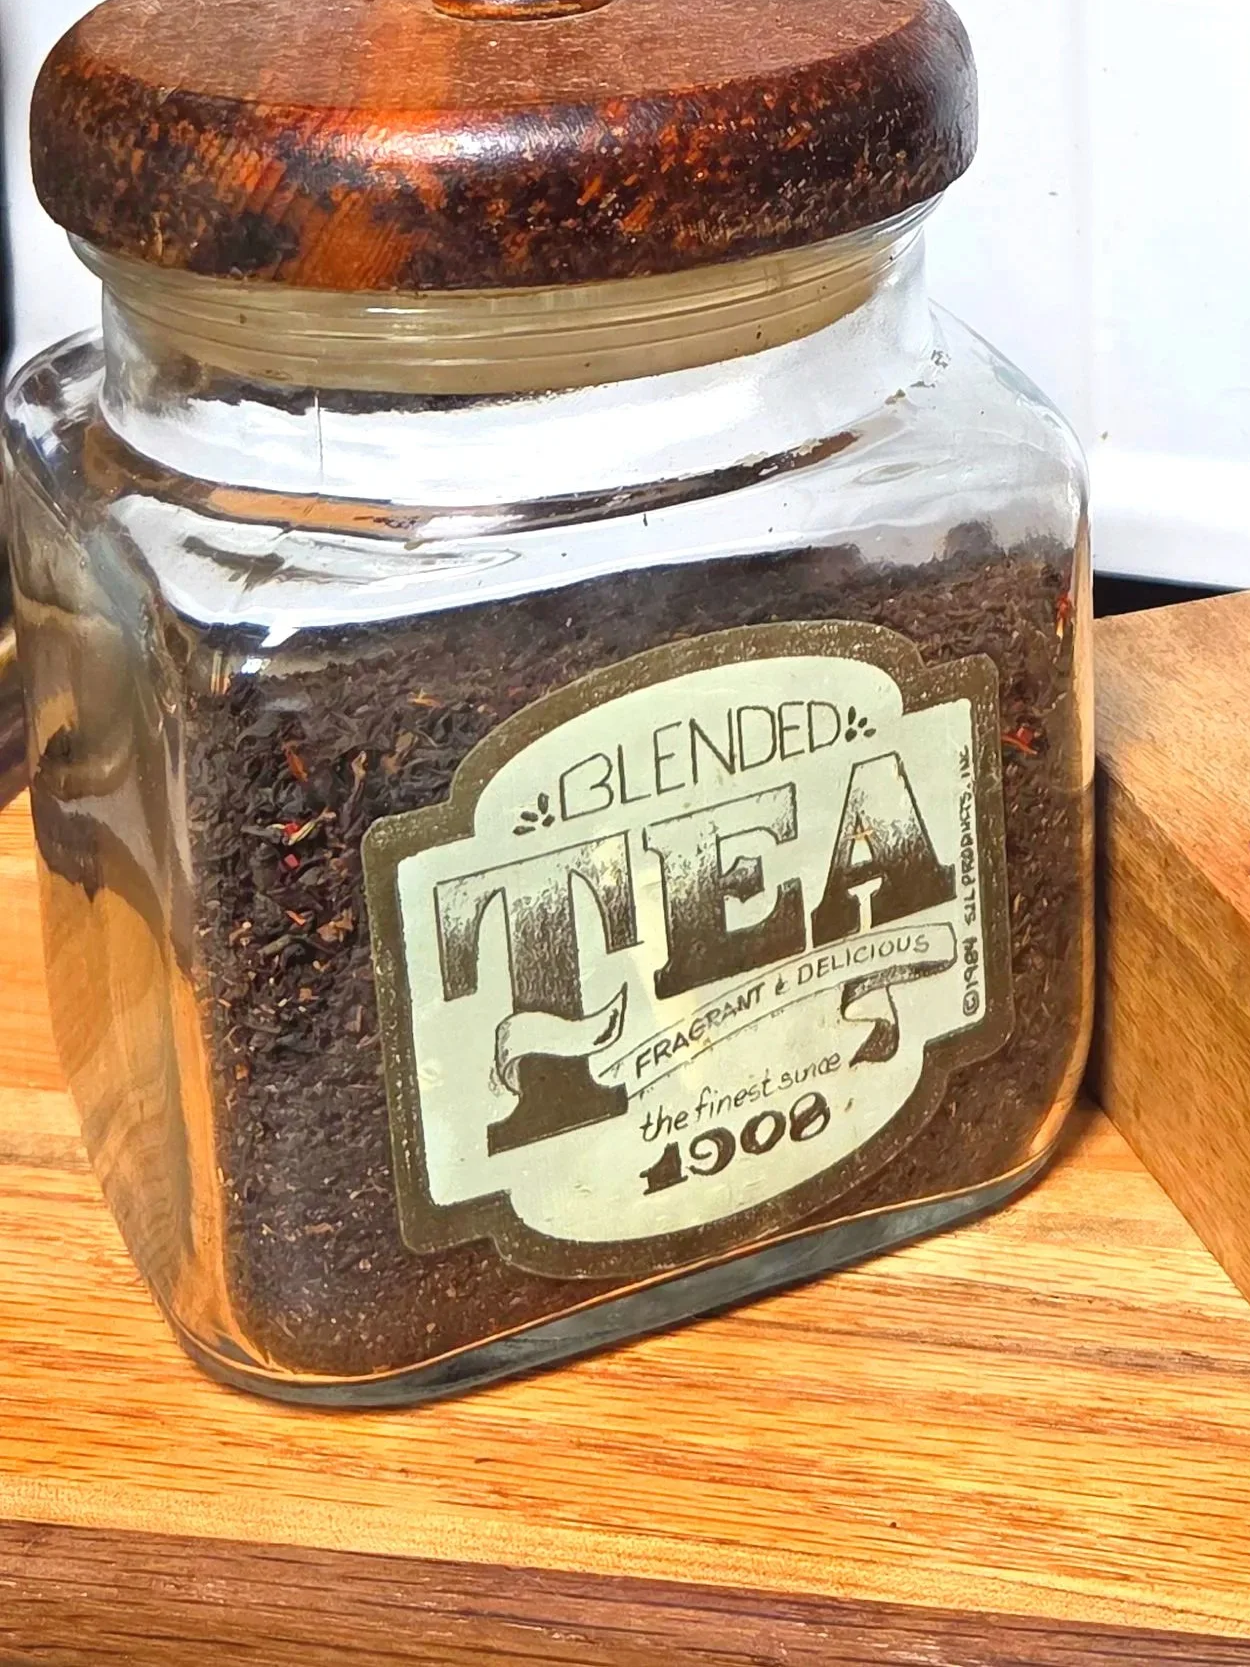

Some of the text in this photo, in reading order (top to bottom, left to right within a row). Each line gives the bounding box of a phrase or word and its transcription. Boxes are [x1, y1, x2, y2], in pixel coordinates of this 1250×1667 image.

[559, 700, 842, 821] BLENDED
[959, 744, 971, 780] INC
[434, 750, 958, 1157] TEA
[635, 982, 767, 1078] FRAGRANT
[796, 932, 931, 986] DELICIOUS
[638, 1090, 832, 1197] 1908
[639, 1051, 842, 1143] the finest since
